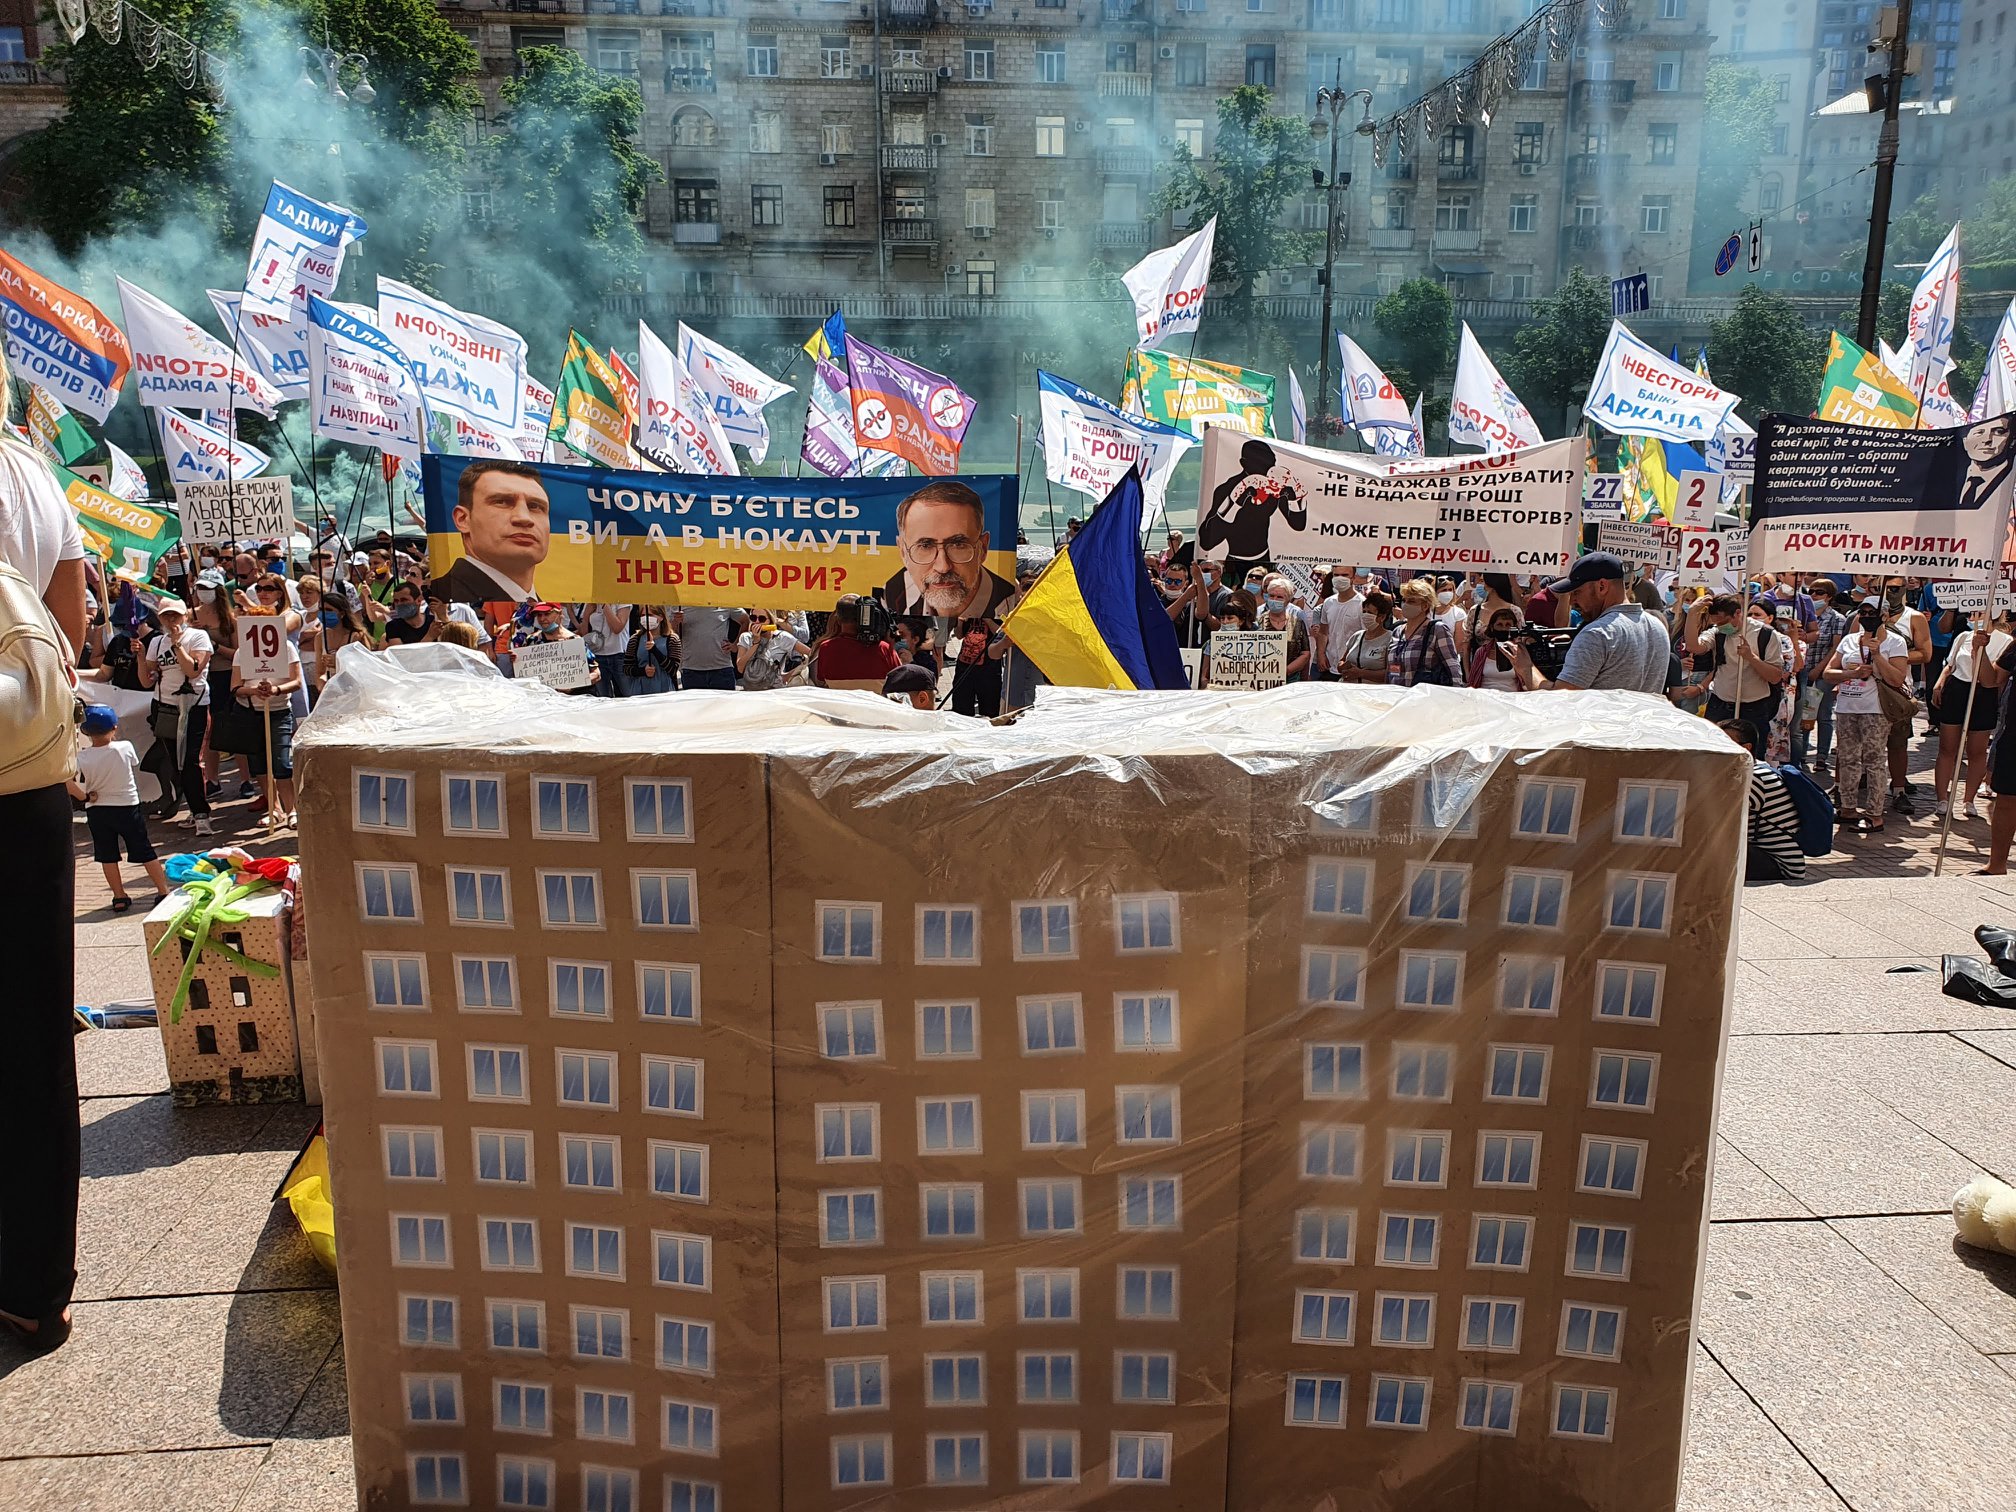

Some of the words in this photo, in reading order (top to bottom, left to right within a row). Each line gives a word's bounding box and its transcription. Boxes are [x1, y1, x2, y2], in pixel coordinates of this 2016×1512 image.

[1, 268, 23, 291] ДА
[28, 284, 47, 307] ТА
[51, 301, 127, 349] АРКАДА!
[7, 339, 84, 395] СТОРІВ
[1622, 353, 1720, 402] ІНВЕСТОРИ
[1172, 396, 1219, 413] НАШІ
[1859, 390, 1874, 404] ЗА
[1602, 392, 1703, 430] АРКАДА
[1787, 425, 1845, 436] розповім
[1847, 427, 1873, 437] Вам
[1875, 431, 1899, 440] про
[1082, 436, 1140, 463] ГРОШІ
[1732, 437, 1758, 459] 34
[1771, 438, 1802, 448] своєї
[1833, 437, 1849, 447] де
[1851, 438, 1859, 447] в
[1769, 451, 1798, 461] один
[1800, 450, 1846, 461] клопіт
[1857, 450, 1909, 463] обрати
[1355, 476, 1451, 488] ЗАВАЖАВ
[1458, 470, 1574, 487] БУДУВАТИ?
[1767, 466, 1828, 477] квартиру
[1830, 466, 1839, 474] в
[1840, 464, 1878, 474] місті
[1880, 466, 1896, 474] чи
[1592, 478, 1621, 499] 27
[1766, 478, 1827, 489] заміський
[587, 487, 697, 515] ЧОМУ
[1355, 486, 1449, 502] ВІДДАЄШ
[1456, 489, 1523, 503] ГРОШІ
[1686, 478, 1706, 508] 2
[1774, 495, 1823, 504] Передвиборча
[1868, 496, 1913, 504] Зеленського
[75, 491, 152, 529] АРКАДО
[188, 493, 284, 520] ЛЬВОВСКИЙ
[1590, 501, 1616, 509] ЗБАРАЖ
[1439, 508, 1573, 525] ІНВЕСТОРІВ?
[1385, 526, 1446, 540] ТЕПЕР
[1452, 528, 1461, 541] І
[1603, 522, 1651, 534] ІНВЕСТОРИ
[1727, 530, 1749, 541] КУД
[1763, 523, 1787, 531] ПАНЕ
[1788, 523, 1852, 532] ПРЕЗИДЕНТЕ,
[568, 519, 631, 552] ВИ,
[644, 523, 669, 547] А
[681, 524, 706, 548] В
[718, 526, 881, 556] НОКАУТІ
[1602, 535, 1638, 544] ВИМАГАЮТЬ
[1642, 538, 1660, 547] СВОЇ
[1784, 533, 1874, 552] ДОСИТЬ
[1879, 535, 1968, 553] МРІЯТИ
[1516, 551, 1570, 566] САМ?
[1686, 538, 1720, 570] 23
[1729, 554, 1746, 567] ГР
[1843, 553, 1861, 563] ТА
[1864, 553, 1959, 568] ІГНОРУВАТИ
[1963, 558, 1994, 571] НАС!
[615, 558, 848, 591] ІНВЕСТОРИ?
[1280, 565, 1309, 595] ДОБУДУЙ
[1935, 585, 1964, 594] КУДИ
[1961, 598, 2009, 607] СОВІТЬ
[246, 624, 279, 658] 19
[1225, 641, 1266, 656] 2020
[1215, 659, 1280, 675] ЛЬВОВСКИЙ
